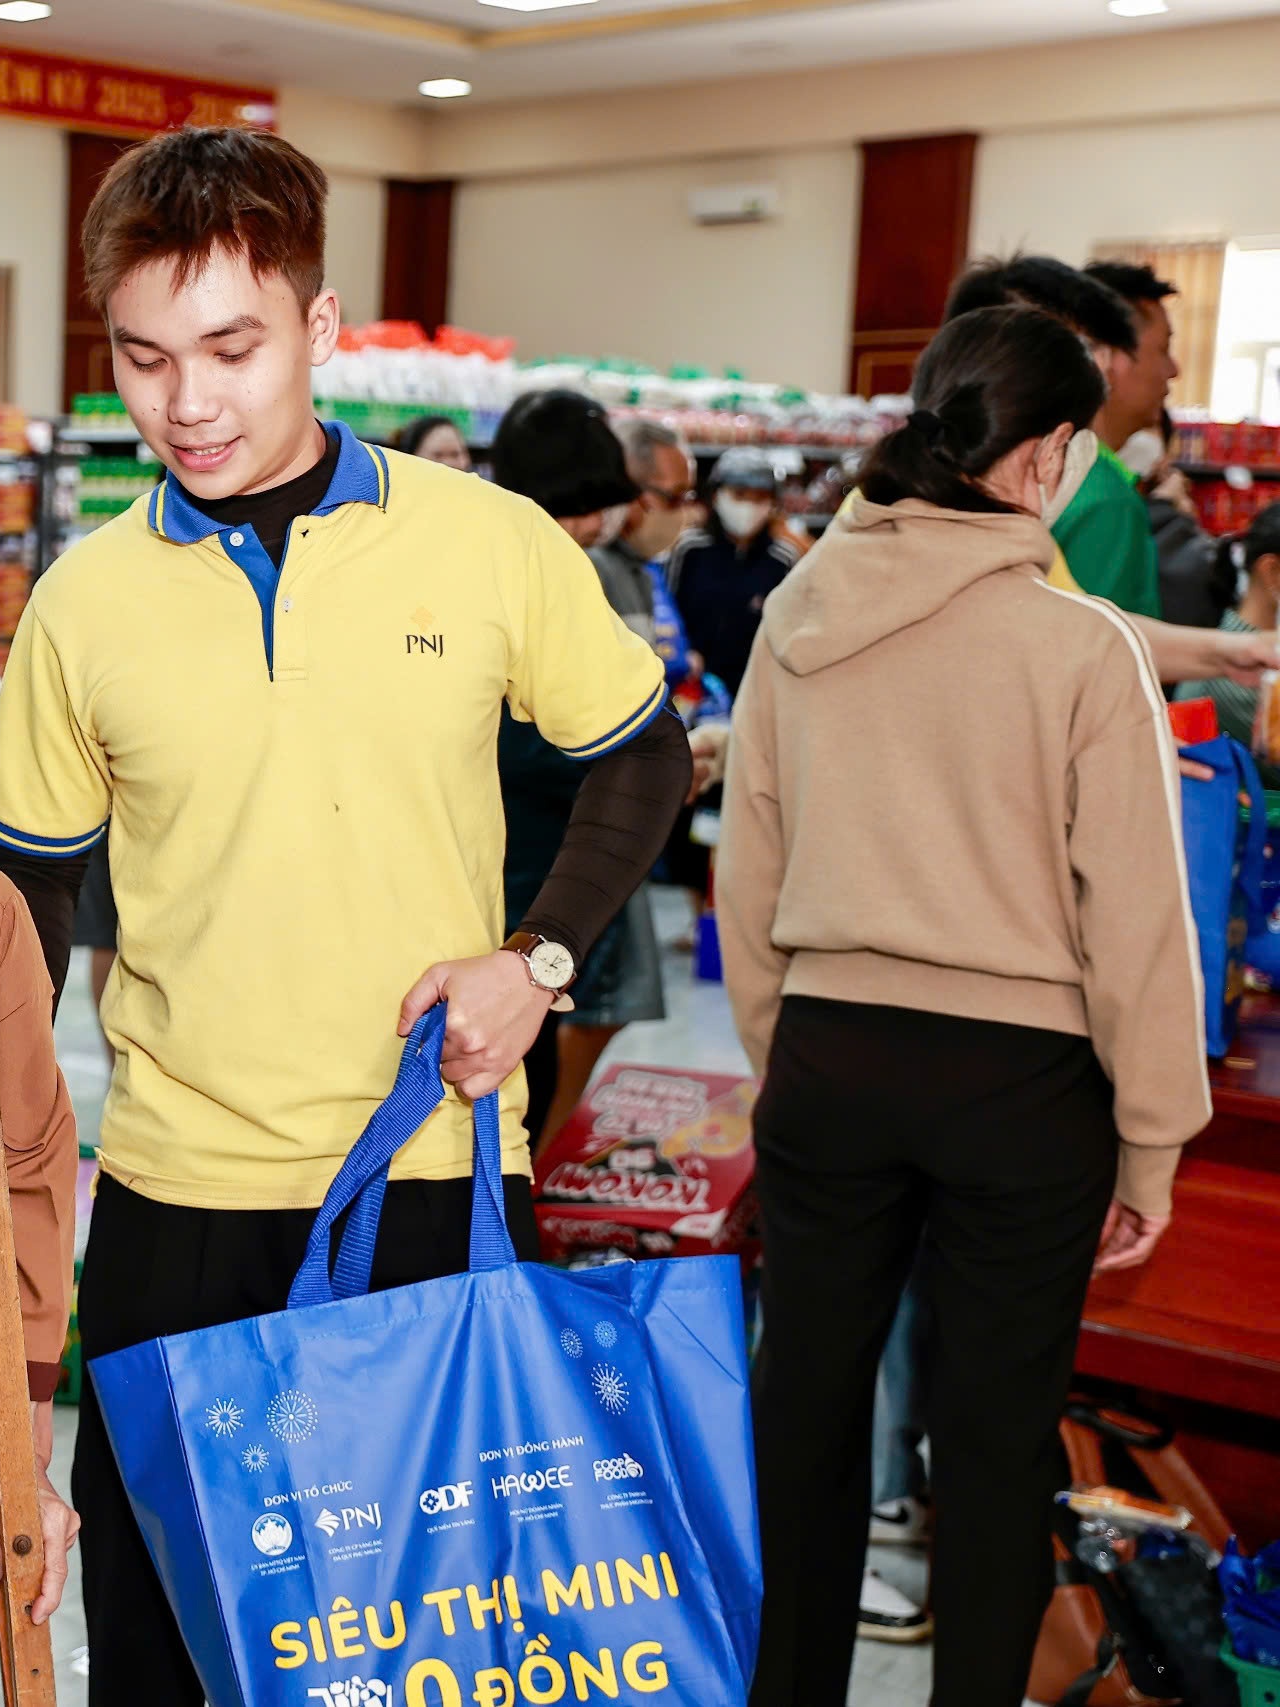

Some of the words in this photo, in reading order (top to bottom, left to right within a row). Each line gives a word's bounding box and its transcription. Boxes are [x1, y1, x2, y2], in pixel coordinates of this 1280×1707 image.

[405, 634, 444, 658] PNJ
[491, 1465, 574, 1499] HAWEE
[340, 1502, 383, 1530] PNJ
[270, 1596, 407, 1669] SIÊU
[422, 1574, 526, 1635] THỊ
[541, 1551, 680, 1616] MINI
[472, 1633, 669, 1707] ĐỒNG
